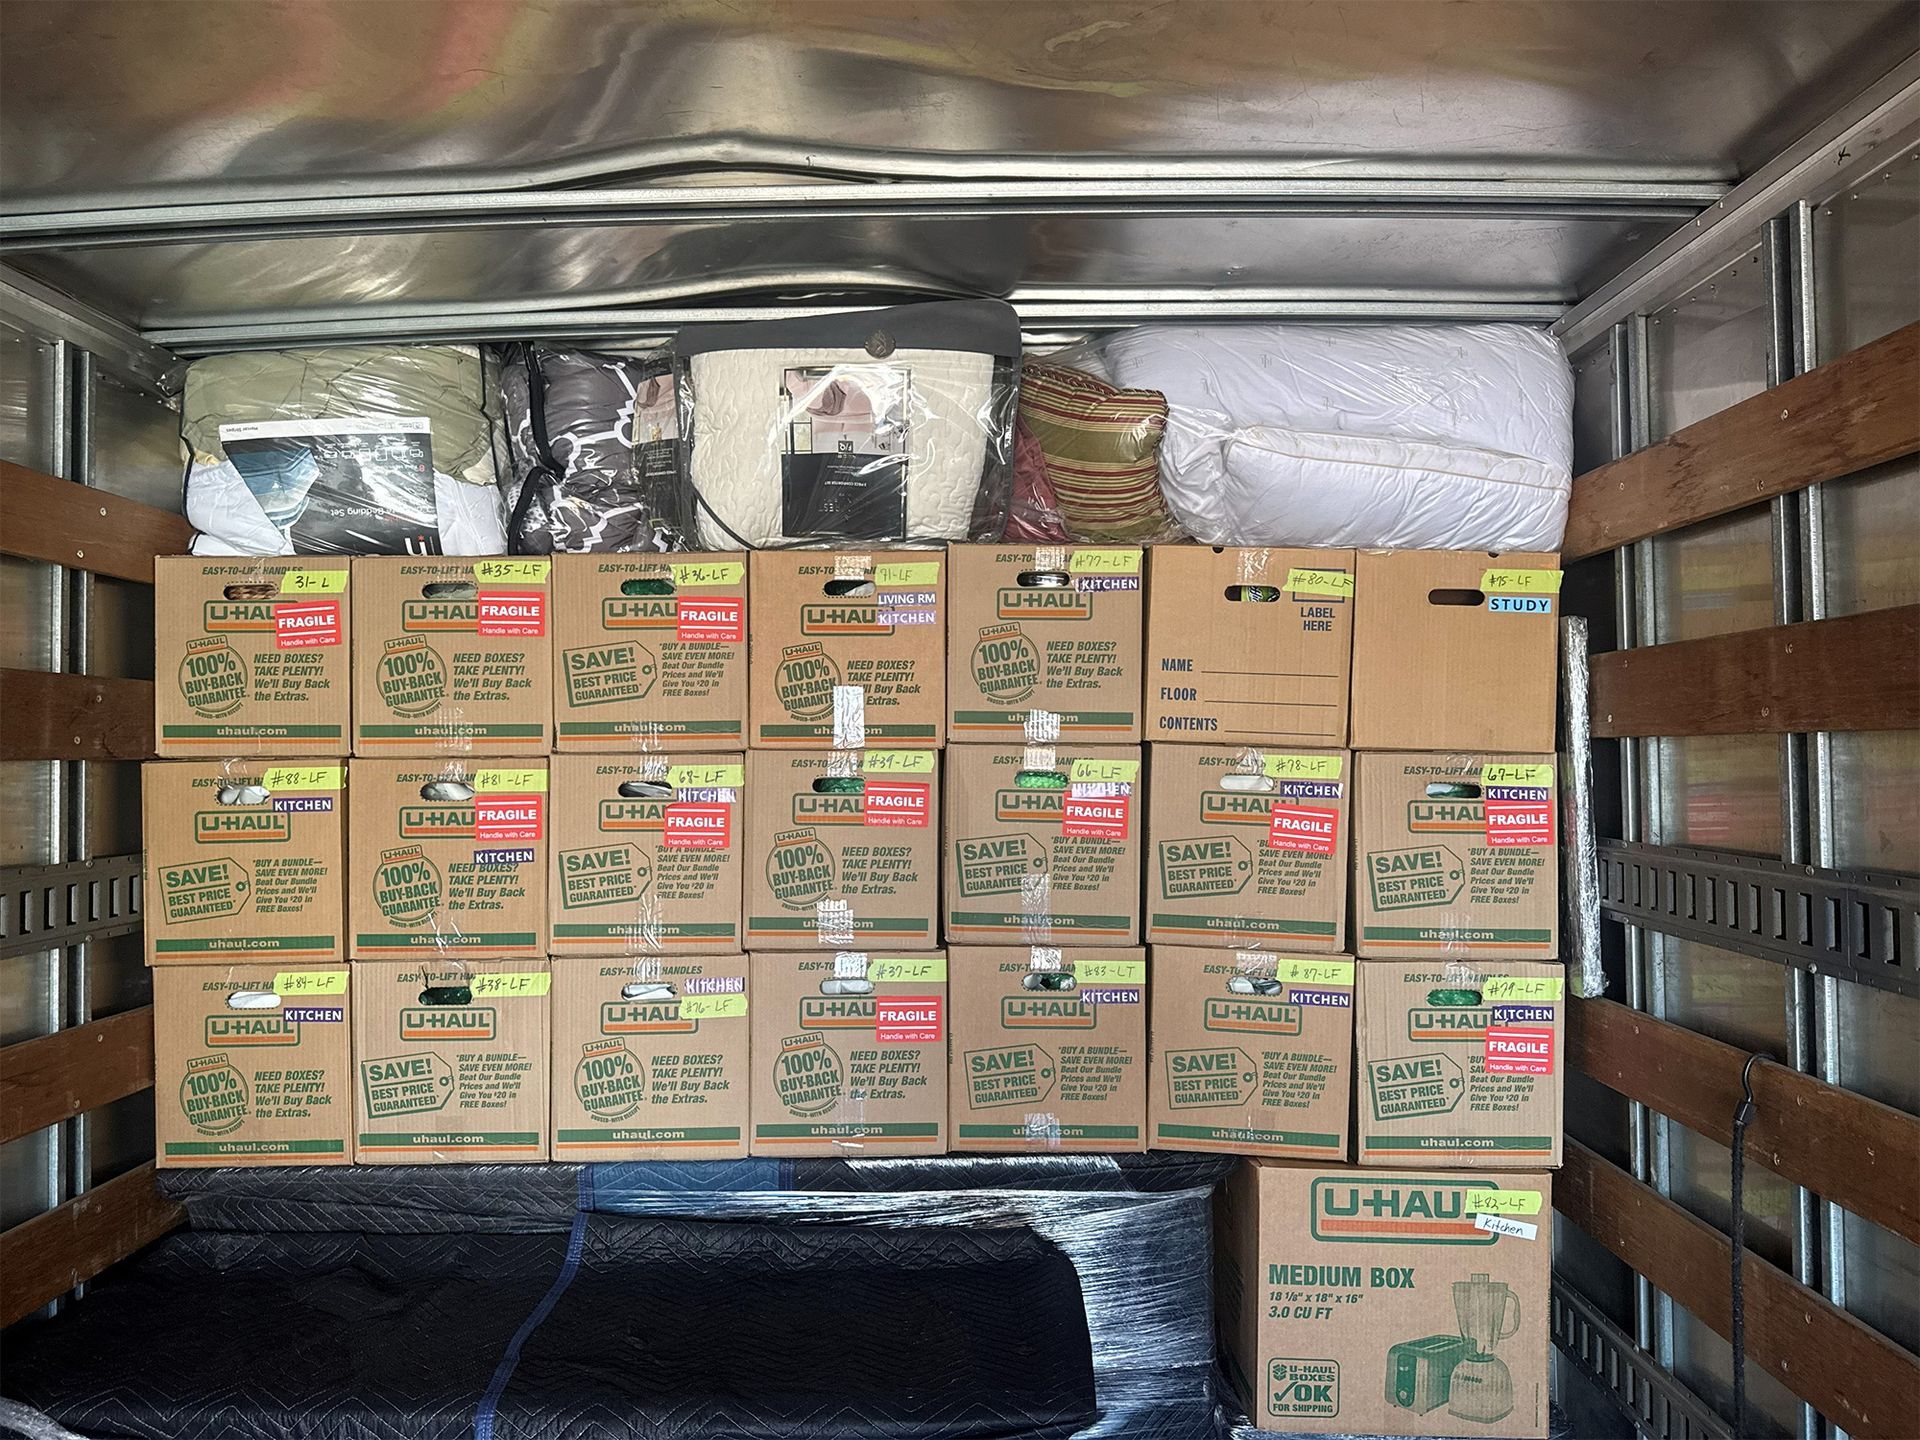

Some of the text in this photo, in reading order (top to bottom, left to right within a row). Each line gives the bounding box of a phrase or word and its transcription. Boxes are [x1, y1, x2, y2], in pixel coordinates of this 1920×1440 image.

[330, 508, 345, 517] Set
[1082, 578, 1137, 589] KITCHEN
[878, 593, 936, 605] LIVING RM
[1004, 593, 1086, 608] U-HAUL
[1491, 598, 1548, 611] STUDY
[409, 605, 478, 619] U-HAU
[481, 606, 540, 616] FRAGILE
[609, 603, 677, 617] U-HAU
[681, 611, 738, 622] FRAGILE
[808, 609, 876, 623] U-HAU
[1301, 607, 1336, 619] LABEL
[278, 615, 335, 629] FRAGILE
[878, 613, 935, 624] KITCHEN
[1303, 620, 1332, 631] HERE
[189, 637, 225, 650] U-HAUL
[979, 639, 1028, 664] 100%
[186, 652, 236, 677] 100%
[254, 654, 324, 664] NEED BOXES?
[384, 651, 435, 677] 100%
[571, 647, 635, 670] SAVE!
[1162, 658, 1193, 672] NAME
[255, 666, 323, 676] TAKE PLENTY!
[783, 658, 830, 683] 100%
[185, 672, 243, 694] BUY-BACK
[255, 678, 330, 691] We'll Buy Back
[255, 692, 309, 701] the Extras.
[1160, 687, 1197, 701] FLOOR
[1159, 716, 1218, 731] CONTENTS
[217, 727, 287, 735] uhaul.com
[414, 726, 487, 735] uhaul.com
[1284, 785, 1341, 796] KITCHEN
[1488, 788, 1547, 800] KITCHEN
[275, 799, 331, 811] KITCHEN
[868, 796, 924, 807] FRAGILE
[478, 809, 537, 821] FRAGILE
[1066, 806, 1123, 818] FRAGILE
[1415, 806, 1485, 820] U-HAU
[202, 815, 285, 830] U-HAUL
[406, 812, 475, 826] U-HAU
[667, 817, 725, 828] FRAGILE
[1274, 818, 1332, 833] FRAGILE
[1489, 814, 1548, 825] FRAGILE
[963, 839, 1026, 860] SAVE!
[1166, 841, 1231, 862] SAVE!
[476, 851, 533, 863] KITCHEN
[566, 849, 631, 872] SAVE!
[774, 844, 824, 870] 100%
[1375, 851, 1441, 873] SAVE!
[166, 864, 229, 888] SAVE!
[255, 868, 328, 877] SAVE EVEN MORE!
[381, 861, 431, 887] 100%
[168, 888, 231, 906] BEST PRICE
[1207, 918, 1280, 930] uhaul.com
[1420, 930, 1494, 939] uhaul.com
[208, 938, 280, 948] uhaul.com
[661, 966, 703, 975] HANDLES
[685, 978, 744, 993] KITCHEN
[1082, 992, 1138, 1003] KITCHEN
[1291, 993, 1349, 1006] KITCHEN
[285, 1010, 342, 1021] KITCHEN
[608, 1006, 678, 1022] U-HAU
[806, 1002, 876, 1017] U-HAU
[879, 1010, 936, 1021] FRAGILE
[1008, 1002, 1090, 1016] U-HAUL
[1211, 1004, 1296, 1023] U-HAUL
[1494, 1009, 1553, 1021] KITCHEN
[406, 1013, 490, 1028] U-HAUL
[212, 1020, 294, 1035] U-HAUL
[585, 1040, 622, 1052] U-HAUL
[1489, 1041, 1548, 1054] FRAGILE
[651, 1055, 723, 1066] NEED BOXES?
[781, 1049, 832, 1076] 100%
[971, 1050, 1035, 1072] SAVE!
[1172, 1053, 1236, 1073] SAVE!
[369, 1058, 432, 1082] SAVE!
[582, 1054, 633, 1081] 100%
[652, 1067, 723, 1078] TAKE PLENTY!
[1376, 1059, 1442, 1083] SAVE!
[187, 1070, 236, 1097] 100%
[581, 1075, 640, 1098] BUY-BACK
[1470, 1103, 1490, 1111] FREE
[612, 1130, 685, 1139] uhaul.com
[811, 1125, 882, 1134] uhaul.com
[413, 1134, 484, 1144] uhaul.com
[1420, 1138, 1494, 1147] uhaul.com
[219, 1142, 289, 1152] uhaul.com
[1324, 1188, 1461, 1218] U-HAU
[1483, 1217, 1524, 1236] Kitchen
[1269, 1264, 1415, 1289] MEDIUM BOX
[1269, 1291, 1283, 1302] 18
[1269, 1306, 1333, 1320] 3.0 CU FT
[1289, 1365, 1334, 1374] U-HAUL
[1290, 1374, 1335, 1382] BOXES
[1293, 1384, 1332, 1402] OK
[1273, 1403, 1333, 1413] FOR SHIPPING
